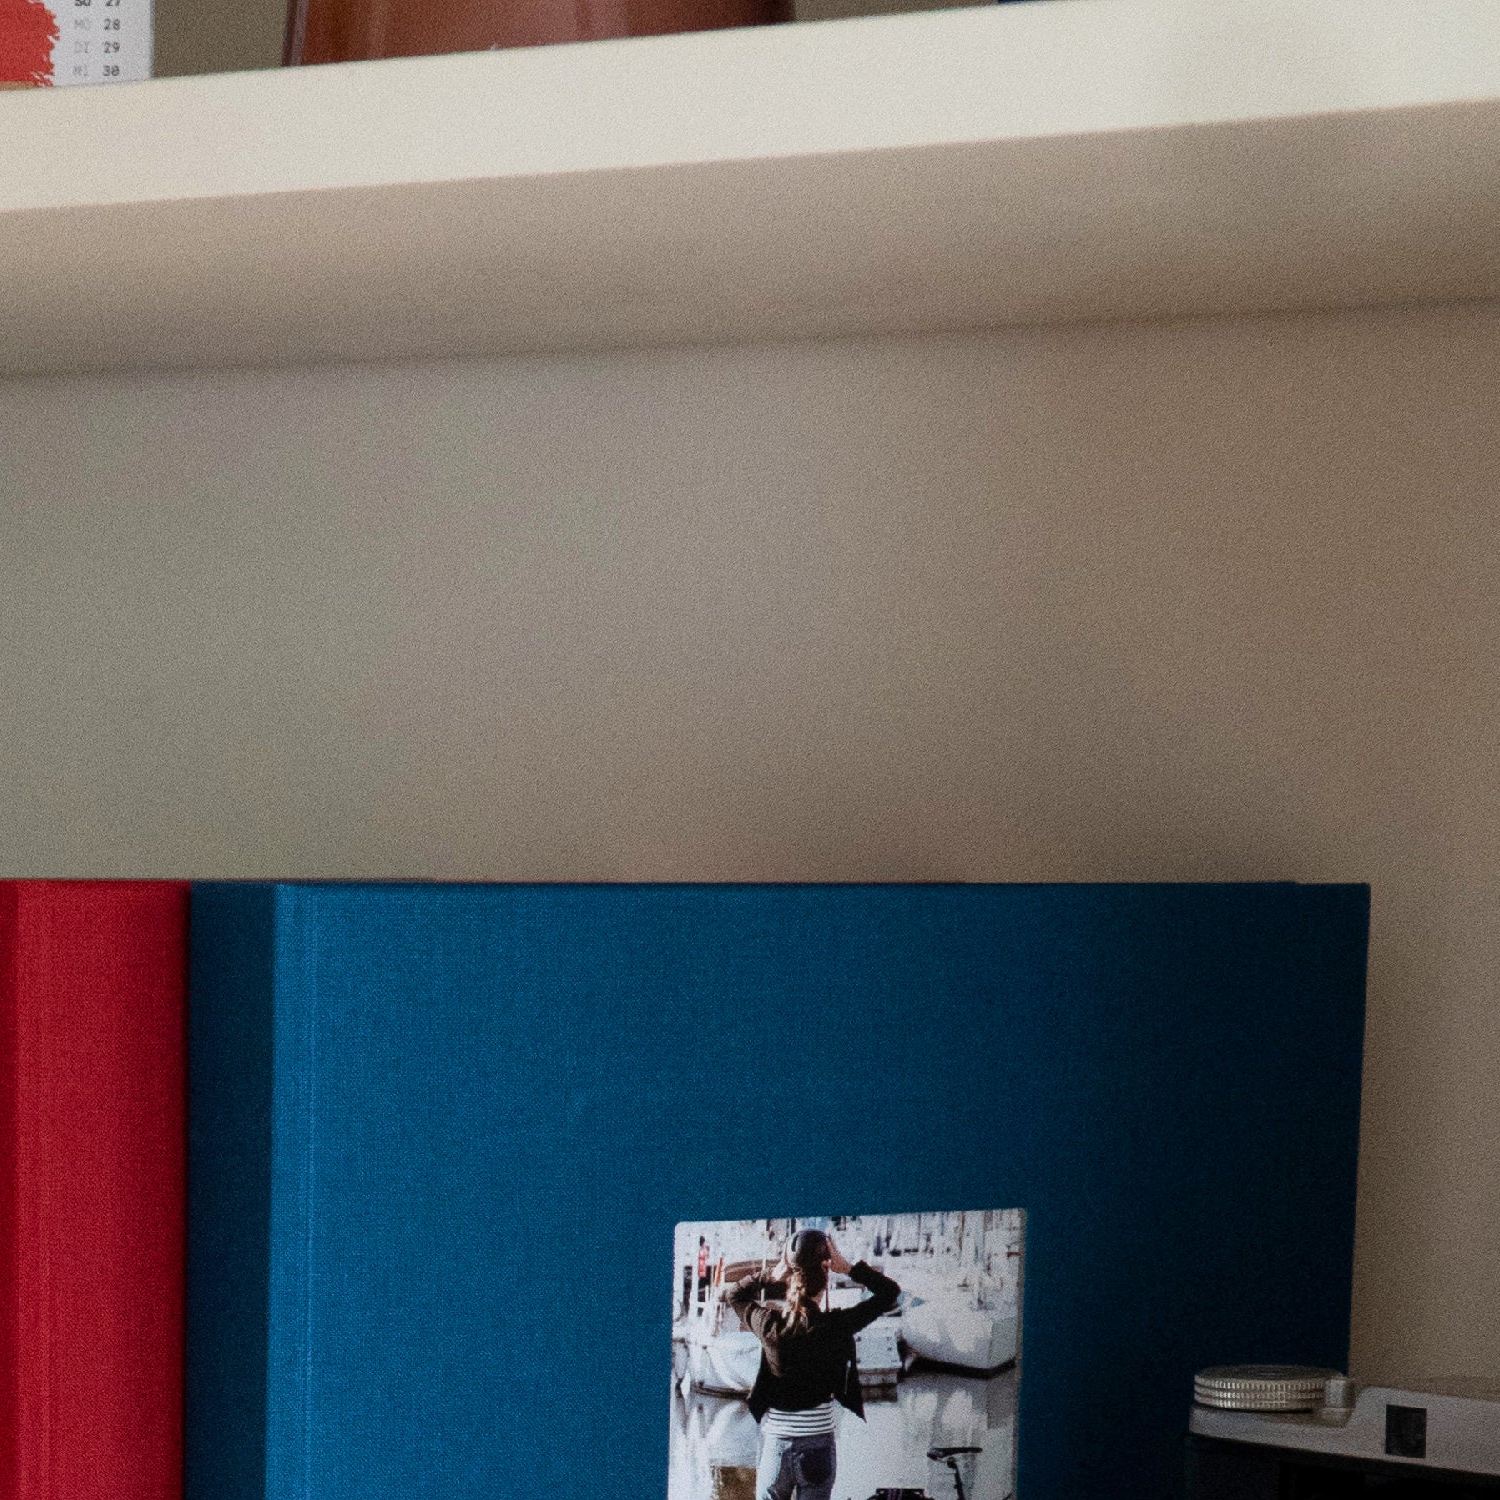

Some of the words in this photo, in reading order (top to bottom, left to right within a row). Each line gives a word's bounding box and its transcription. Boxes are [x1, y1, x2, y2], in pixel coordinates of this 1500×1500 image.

[104, 18, 121, 31] 28
[103, 41, 121, 54] 29
[102, 65, 121, 77] 30
